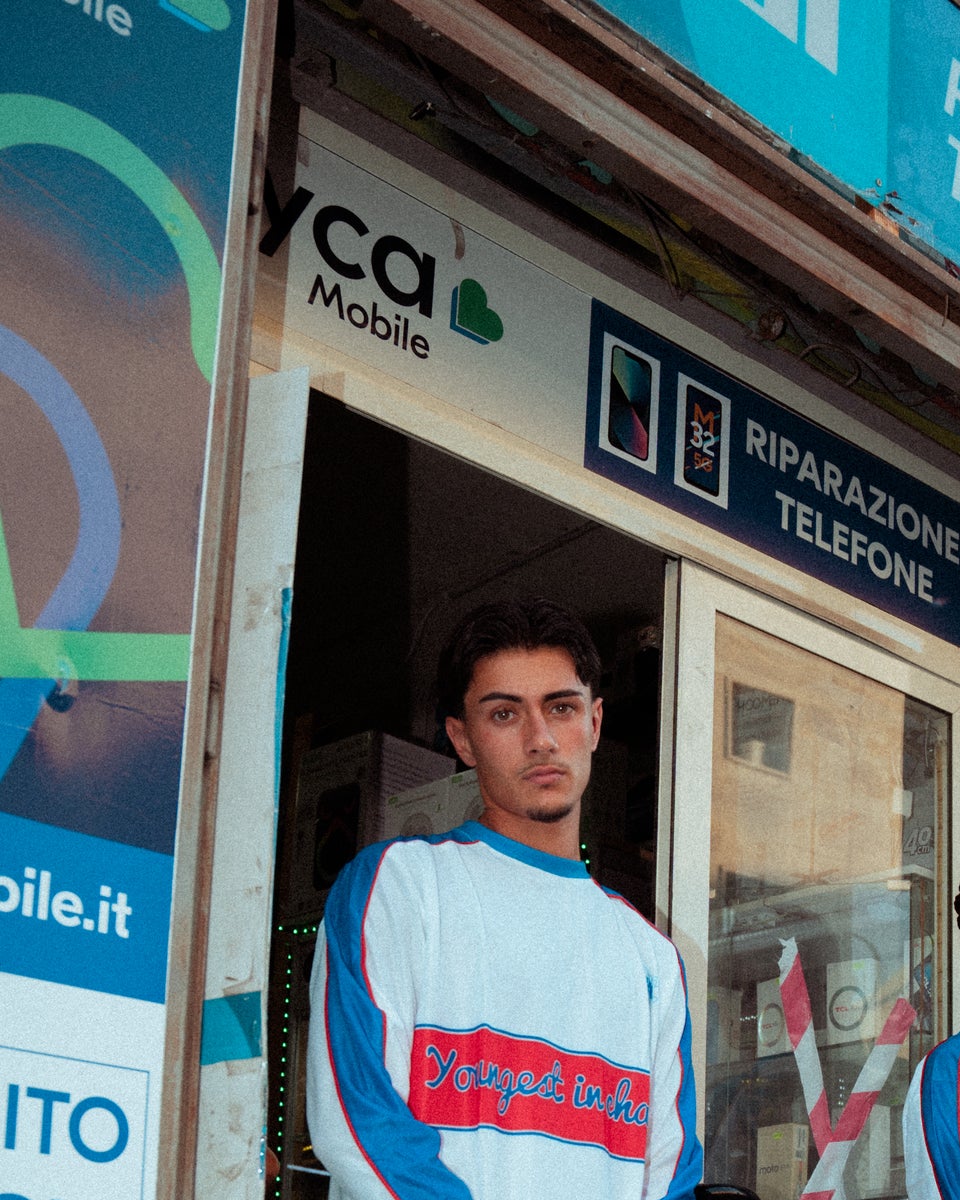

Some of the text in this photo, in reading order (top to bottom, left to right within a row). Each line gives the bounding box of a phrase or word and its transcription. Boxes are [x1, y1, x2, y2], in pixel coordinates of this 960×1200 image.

[63, 0, 133, 37] ile
[307, 274, 430, 360] Mobile
[690, 420, 715, 457] 32
[746, 419, 960, 565] RIPARAZIONE
[775, 490, 934, 603] TELEFONE
[425, 1045, 565, 1116] Youngest
[572, 1074, 605, 1111] in
[5, 1083, 129, 1163] ITO
